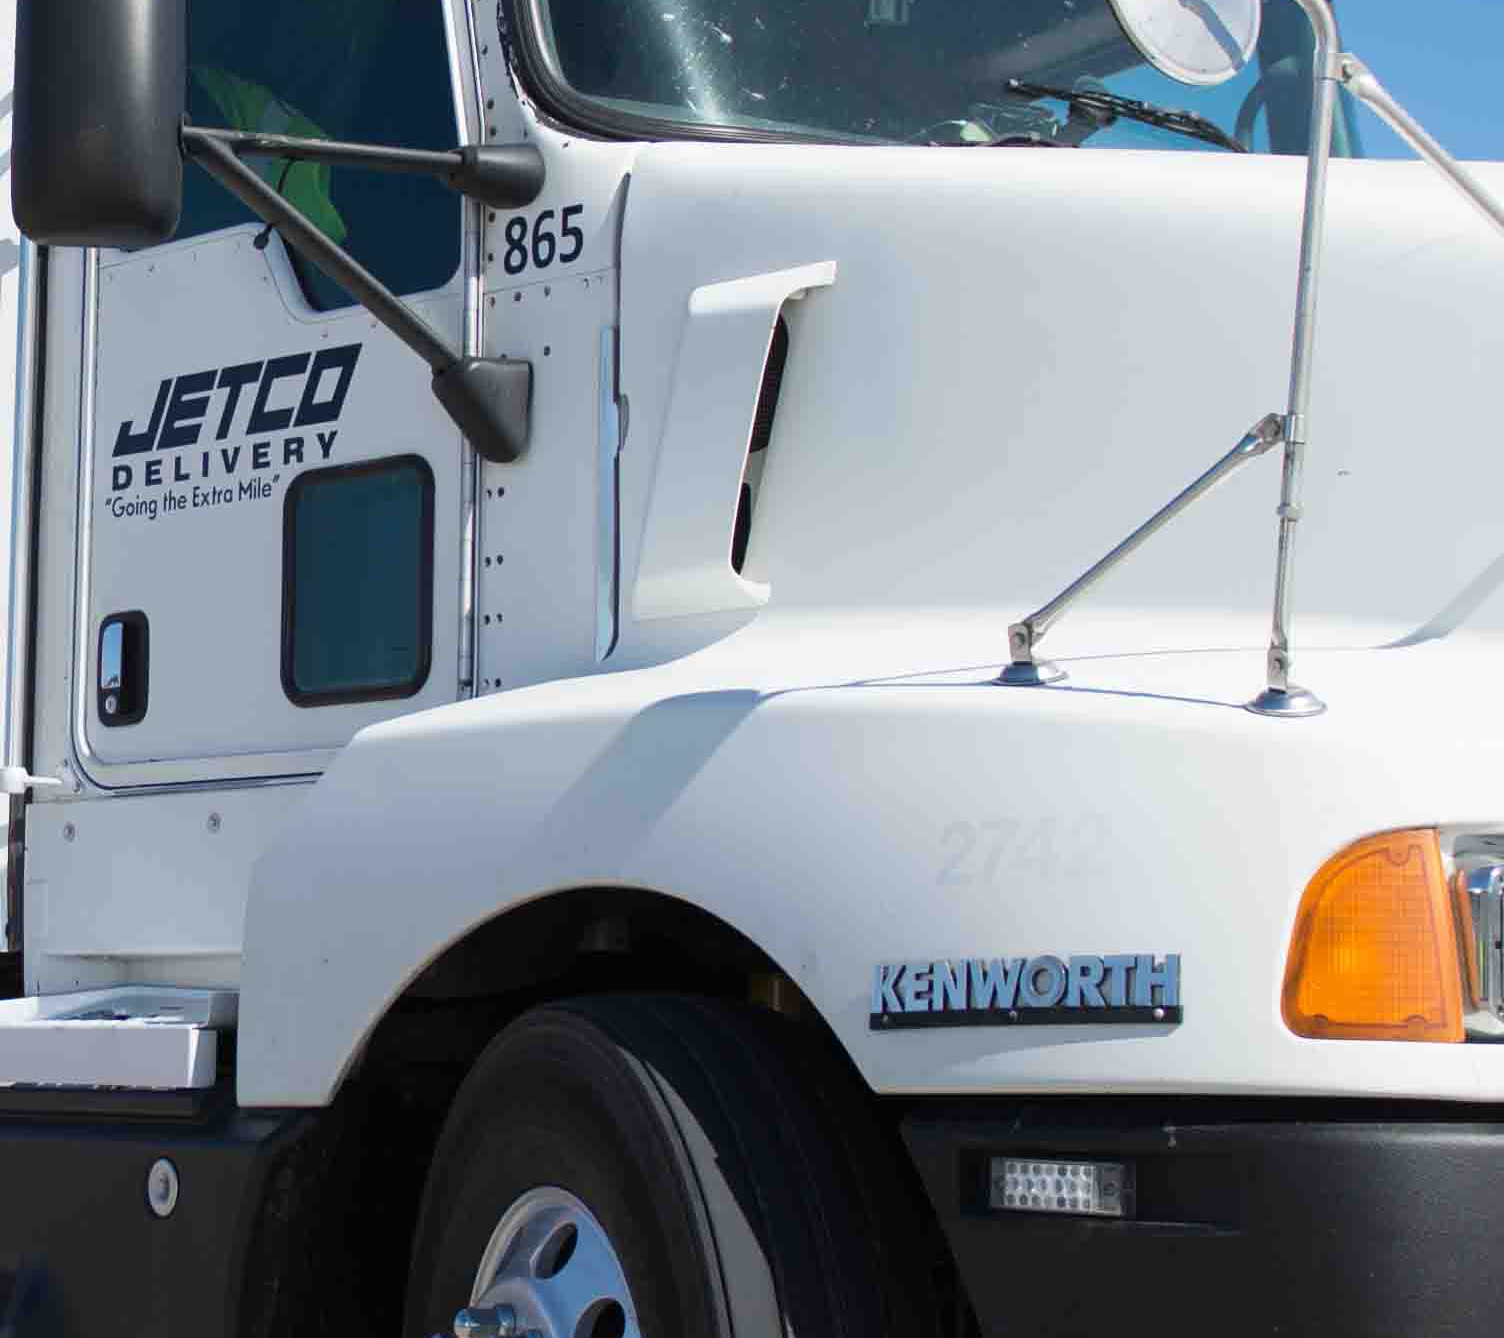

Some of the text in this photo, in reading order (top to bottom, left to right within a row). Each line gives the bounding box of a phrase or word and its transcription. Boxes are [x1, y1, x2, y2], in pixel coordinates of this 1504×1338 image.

[503, 204, 584, 275] 865
[111, 342, 363, 459] JETCO
[111, 430, 339, 493] DELIVERY
[163, 489, 187, 512] the
[192, 486, 233, 509] Extra
[870, 953, 1182, 1015] KENWORTH
